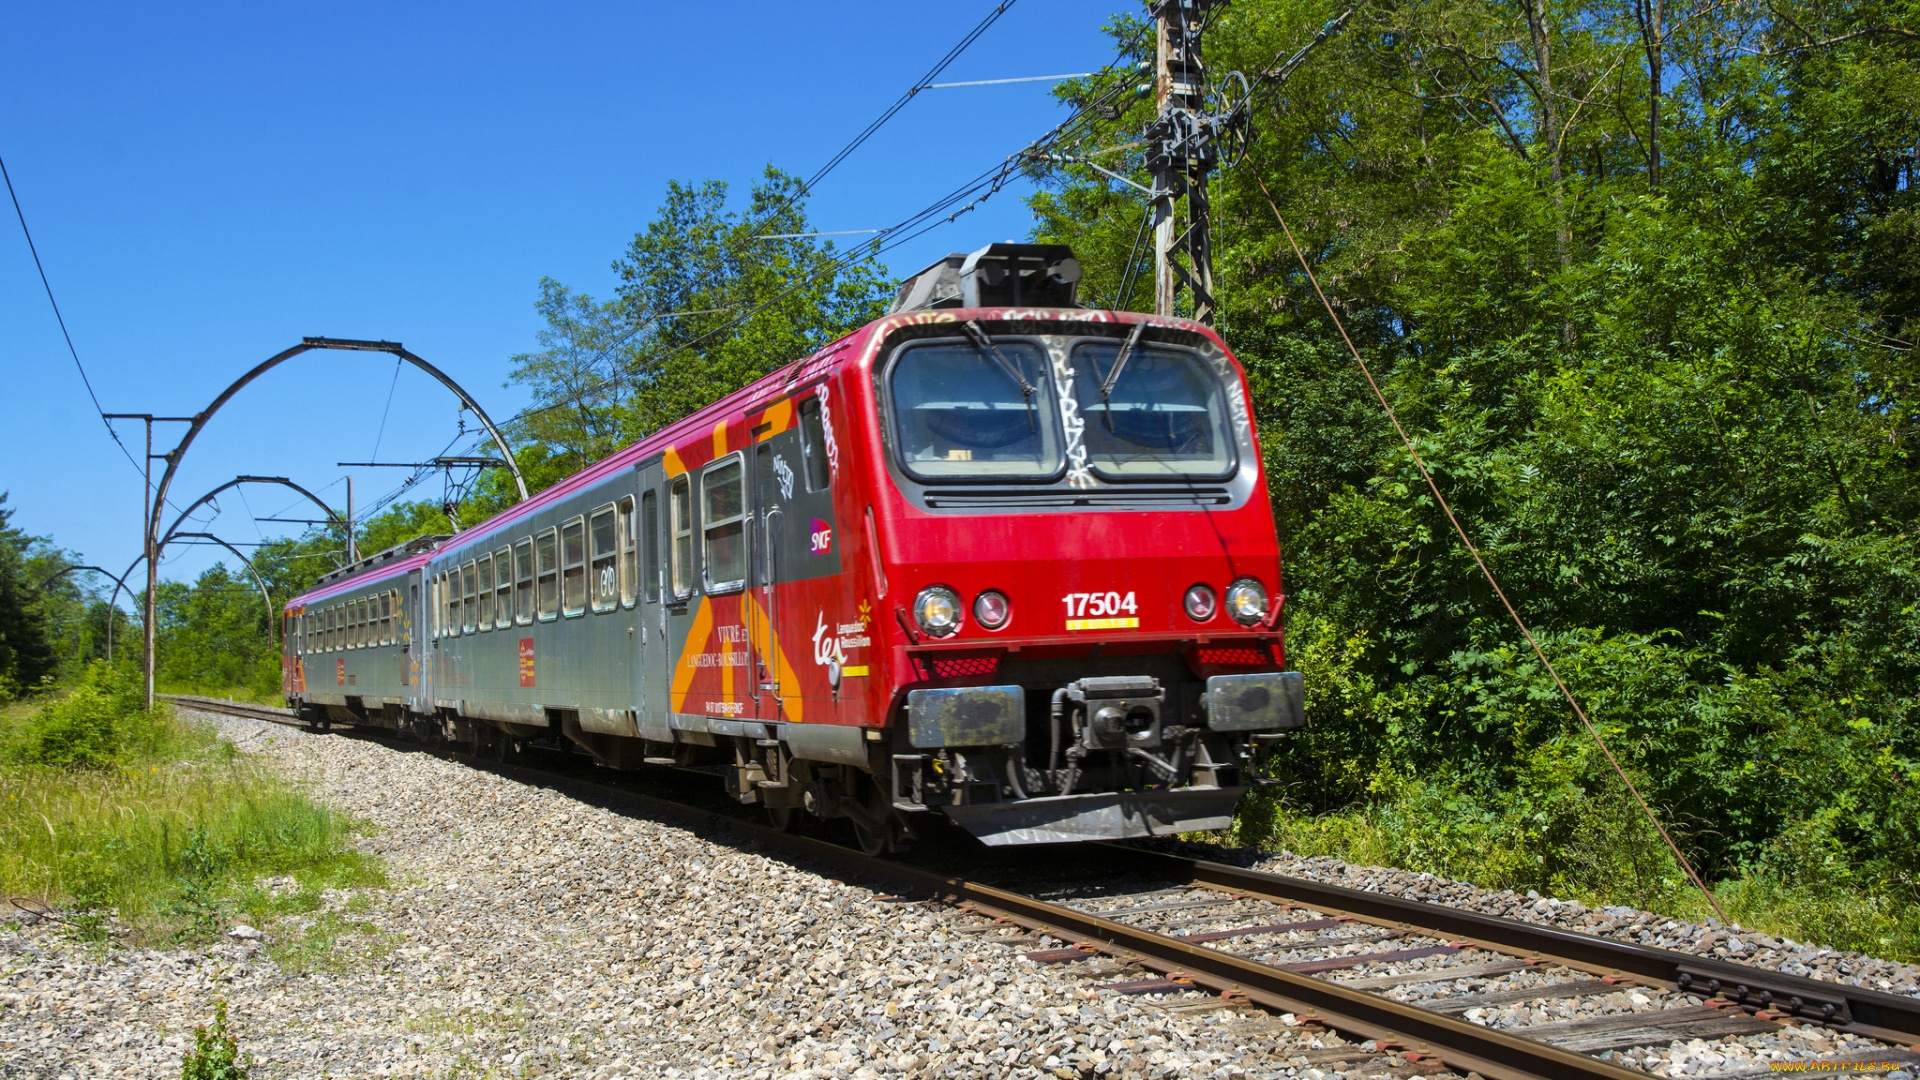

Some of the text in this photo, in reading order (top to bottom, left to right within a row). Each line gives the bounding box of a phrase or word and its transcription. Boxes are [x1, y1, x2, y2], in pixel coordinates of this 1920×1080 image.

[811, 529, 832, 551] SNCF
[1061, 591, 1139, 617] 17504
[717, 624, 741, 644] VIVRE
[812, 610, 849, 666] ter
[836, 620, 865, 637] Languedoc
[840, 634, 872, 649] Roussillon
